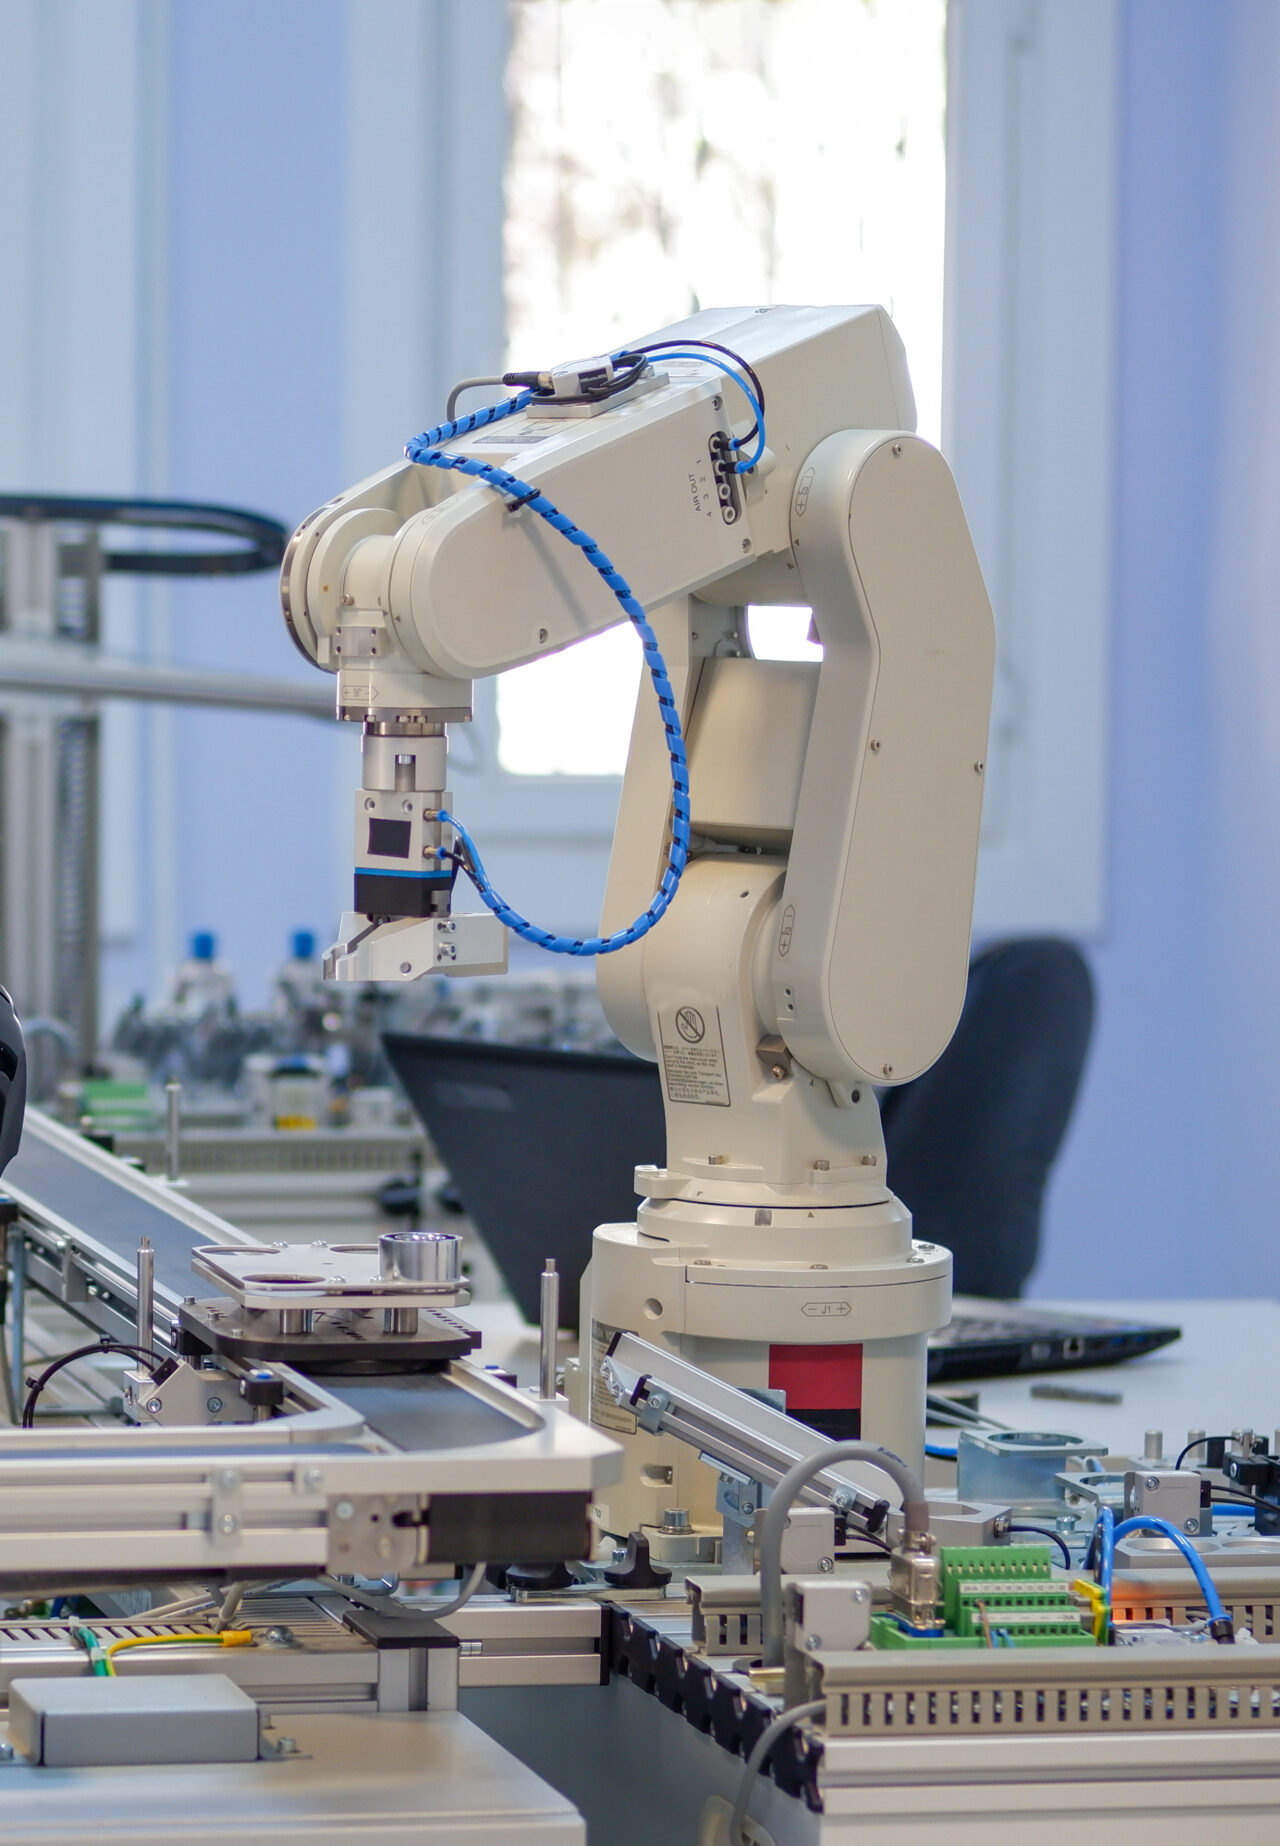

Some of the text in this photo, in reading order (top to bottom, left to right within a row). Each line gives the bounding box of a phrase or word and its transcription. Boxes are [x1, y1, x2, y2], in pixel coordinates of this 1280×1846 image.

[699, 475, 706, 483] 2
[688, 473, 702, 512] AIR OUT
